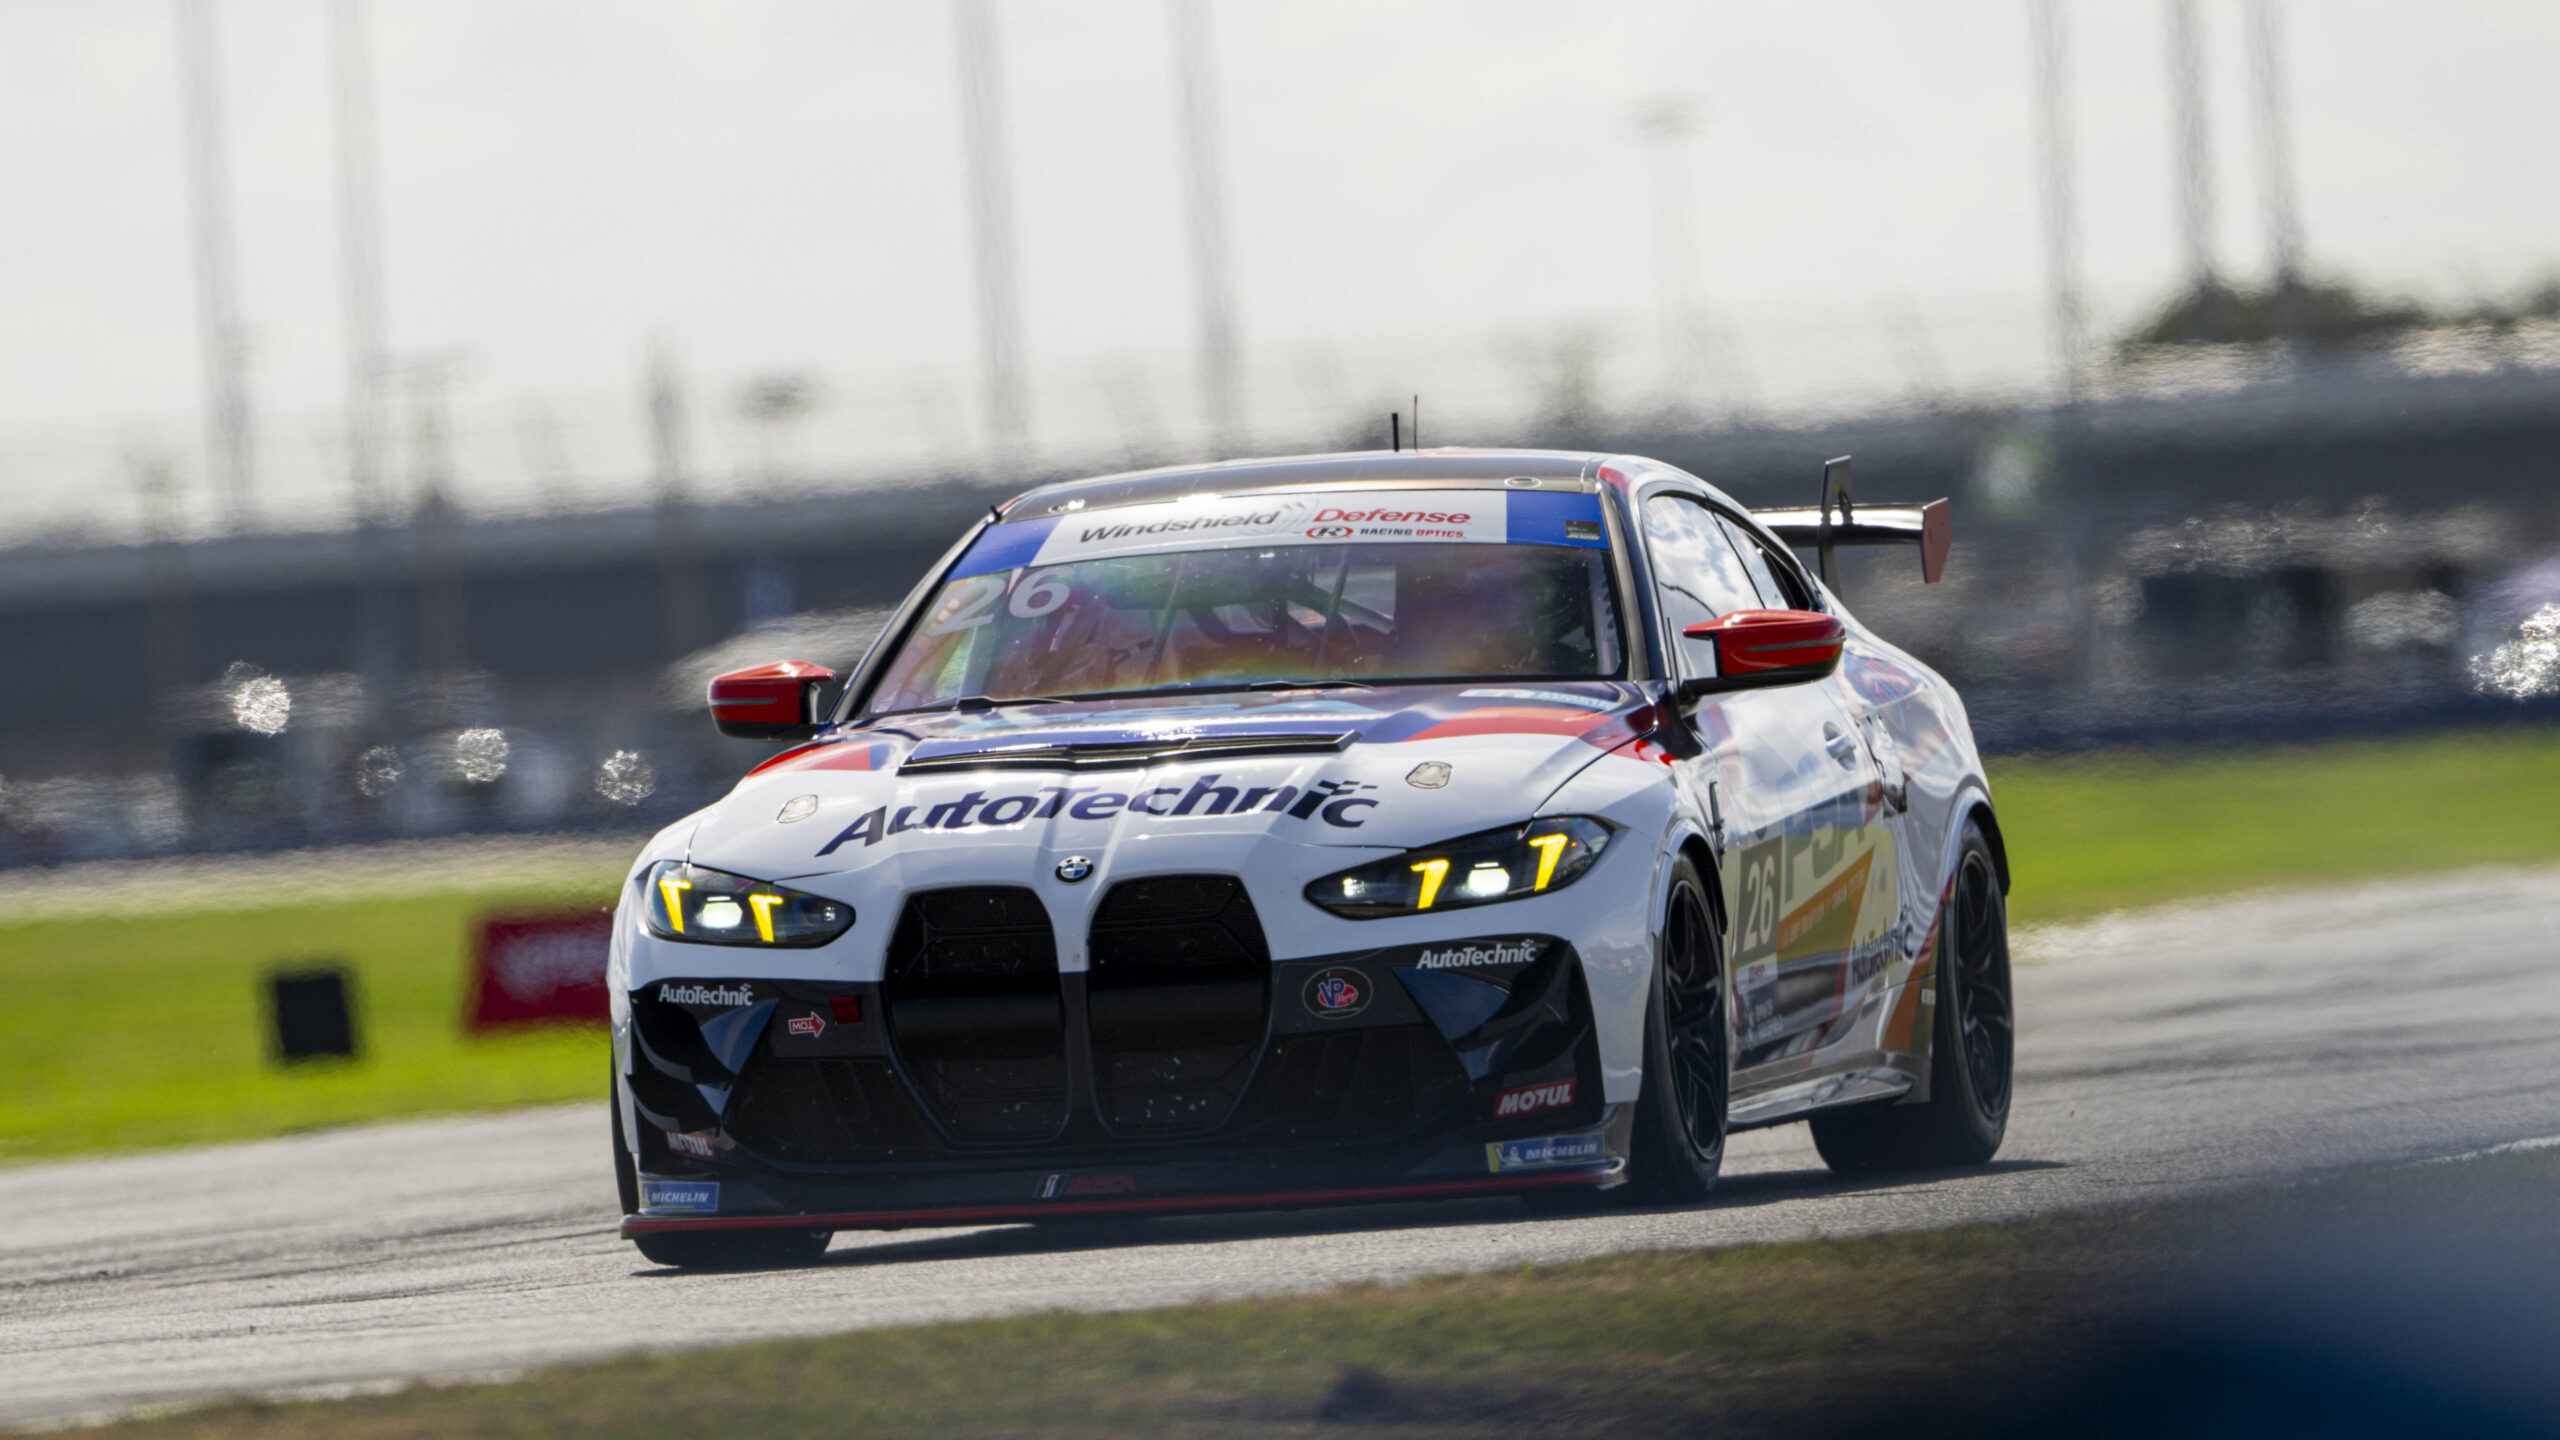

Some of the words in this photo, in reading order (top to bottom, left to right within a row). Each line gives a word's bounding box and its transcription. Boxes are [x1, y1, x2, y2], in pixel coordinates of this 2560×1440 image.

[1080, 510, 1281, 543] Windshield
[1312, 508, 1471, 524] Defense
[1360, 528, 1413, 536] RACING
[1416, 529, 1464, 538] OPTICS
[930, 566, 1076, 637] 26
[814, 773, 1380, 858] AutoTechnic
[1743, 855, 1775, 952] 26
[1416, 939, 1536, 969] AutoTechnic
[659, 983, 753, 1006] AutoTechnic
[1317, 978, 1346, 1008] VP
[1497, 1084, 1571, 1115] MOTUL
[666, 1131, 713, 1156] MOTUL
[1525, 1143, 1598, 1160] MICHELIN
[651, 1191, 710, 1203] MICHELIN
